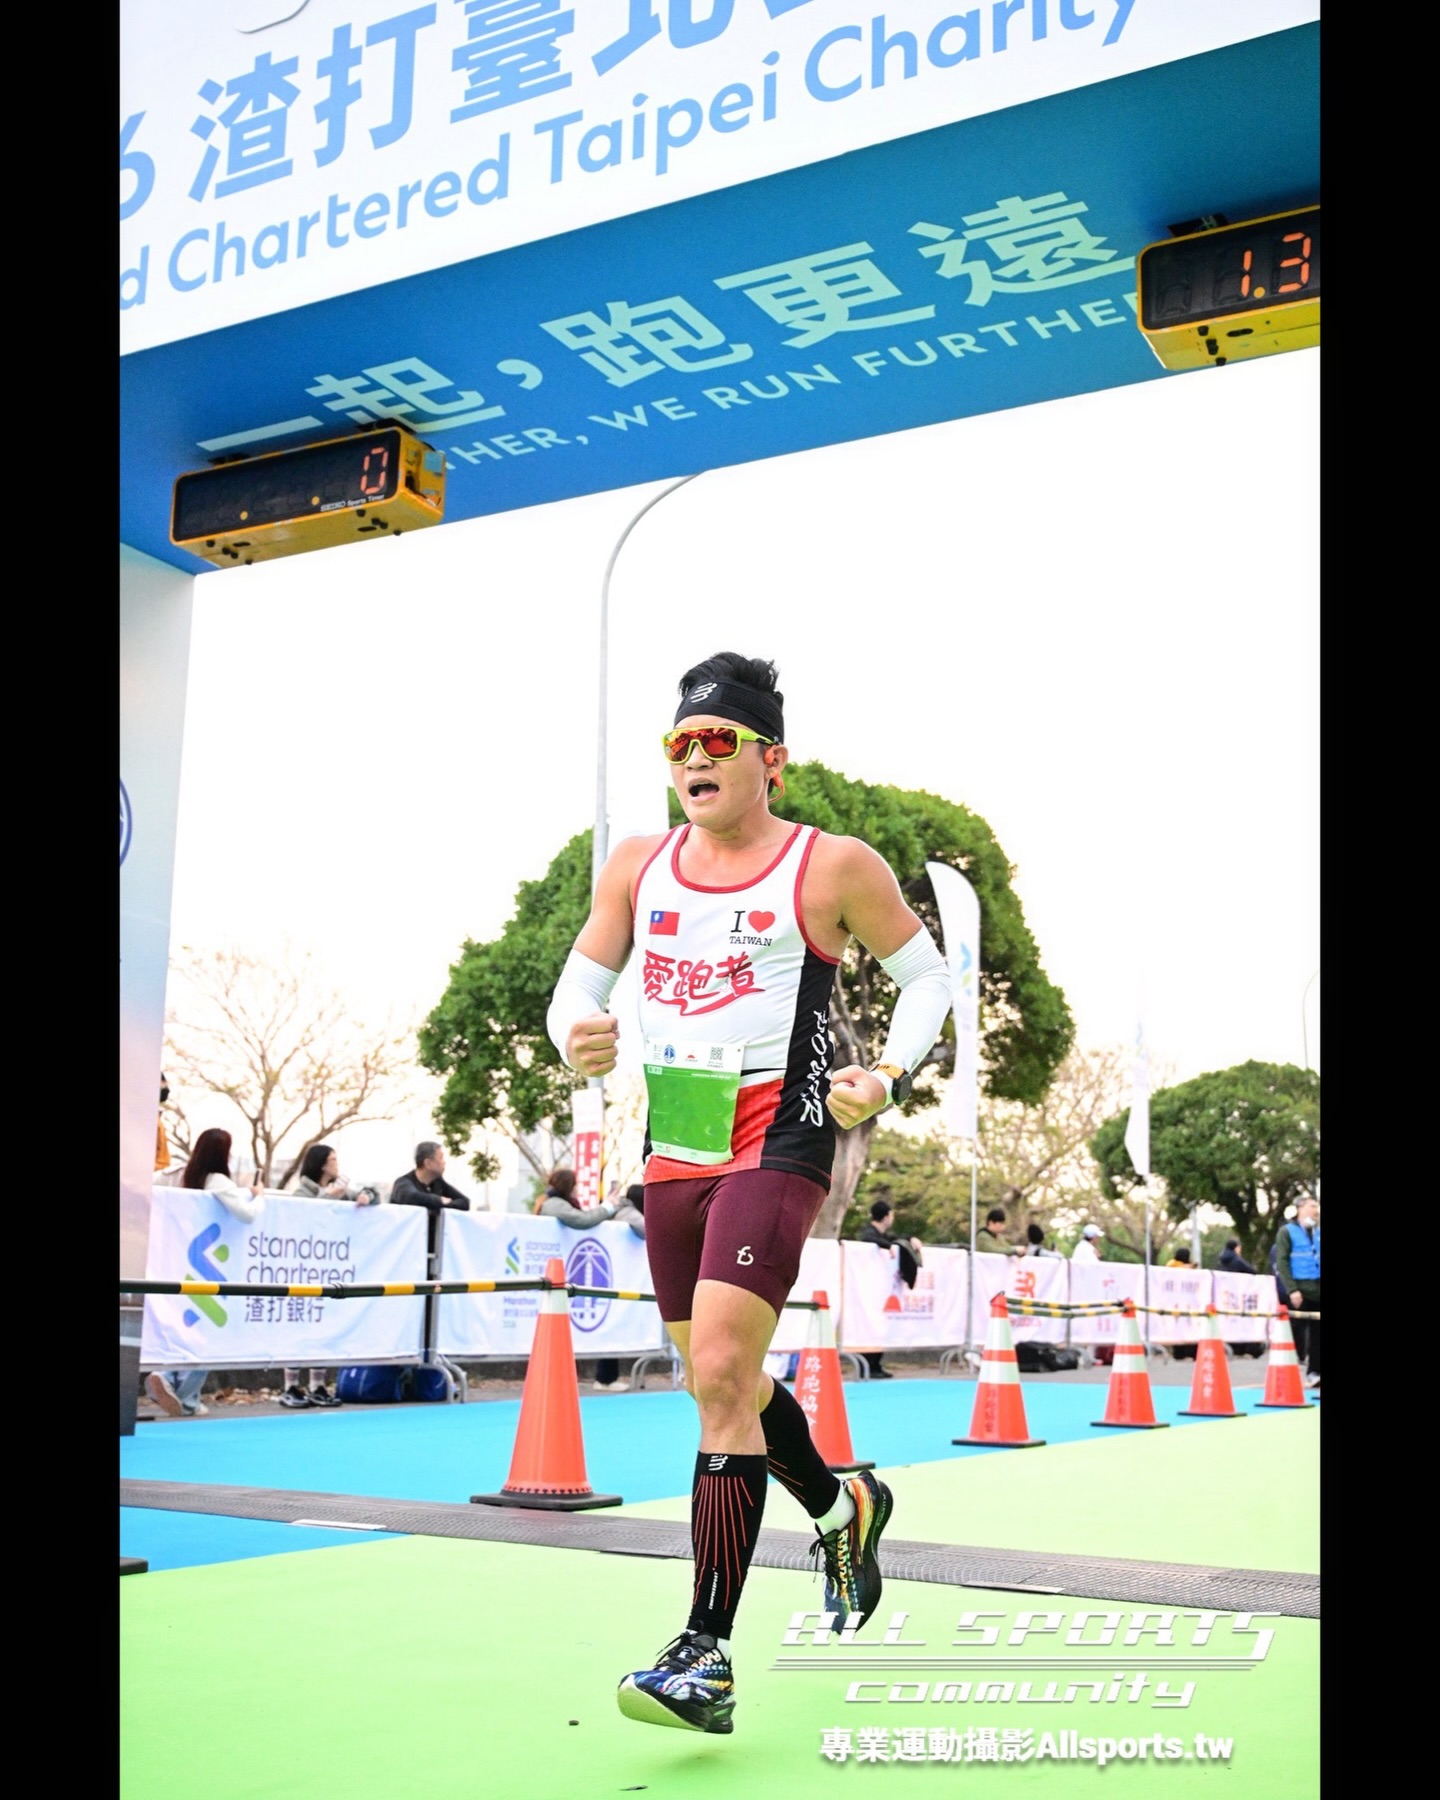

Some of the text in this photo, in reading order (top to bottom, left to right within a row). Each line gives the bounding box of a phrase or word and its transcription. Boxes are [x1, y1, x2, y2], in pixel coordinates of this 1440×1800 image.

[188, 0, 813, 203] 渣打臺北
[168, 133, 511, 293] Chartered
[534, 51, 781, 185] Taipei
[804, 0, 1136, 102] Charity
[446, 427, 589, 470] HER,
[587, 397, 698, 432] WE
[702, 364, 842, 410] RUN
[731, 910, 746, 933] I
[729, 935, 773, 947] TAIWAN
[247, 1232, 350, 1261] standard
[247, 1261, 356, 1284] chartered
[245, 1296, 325, 1323] 渣打銀行
